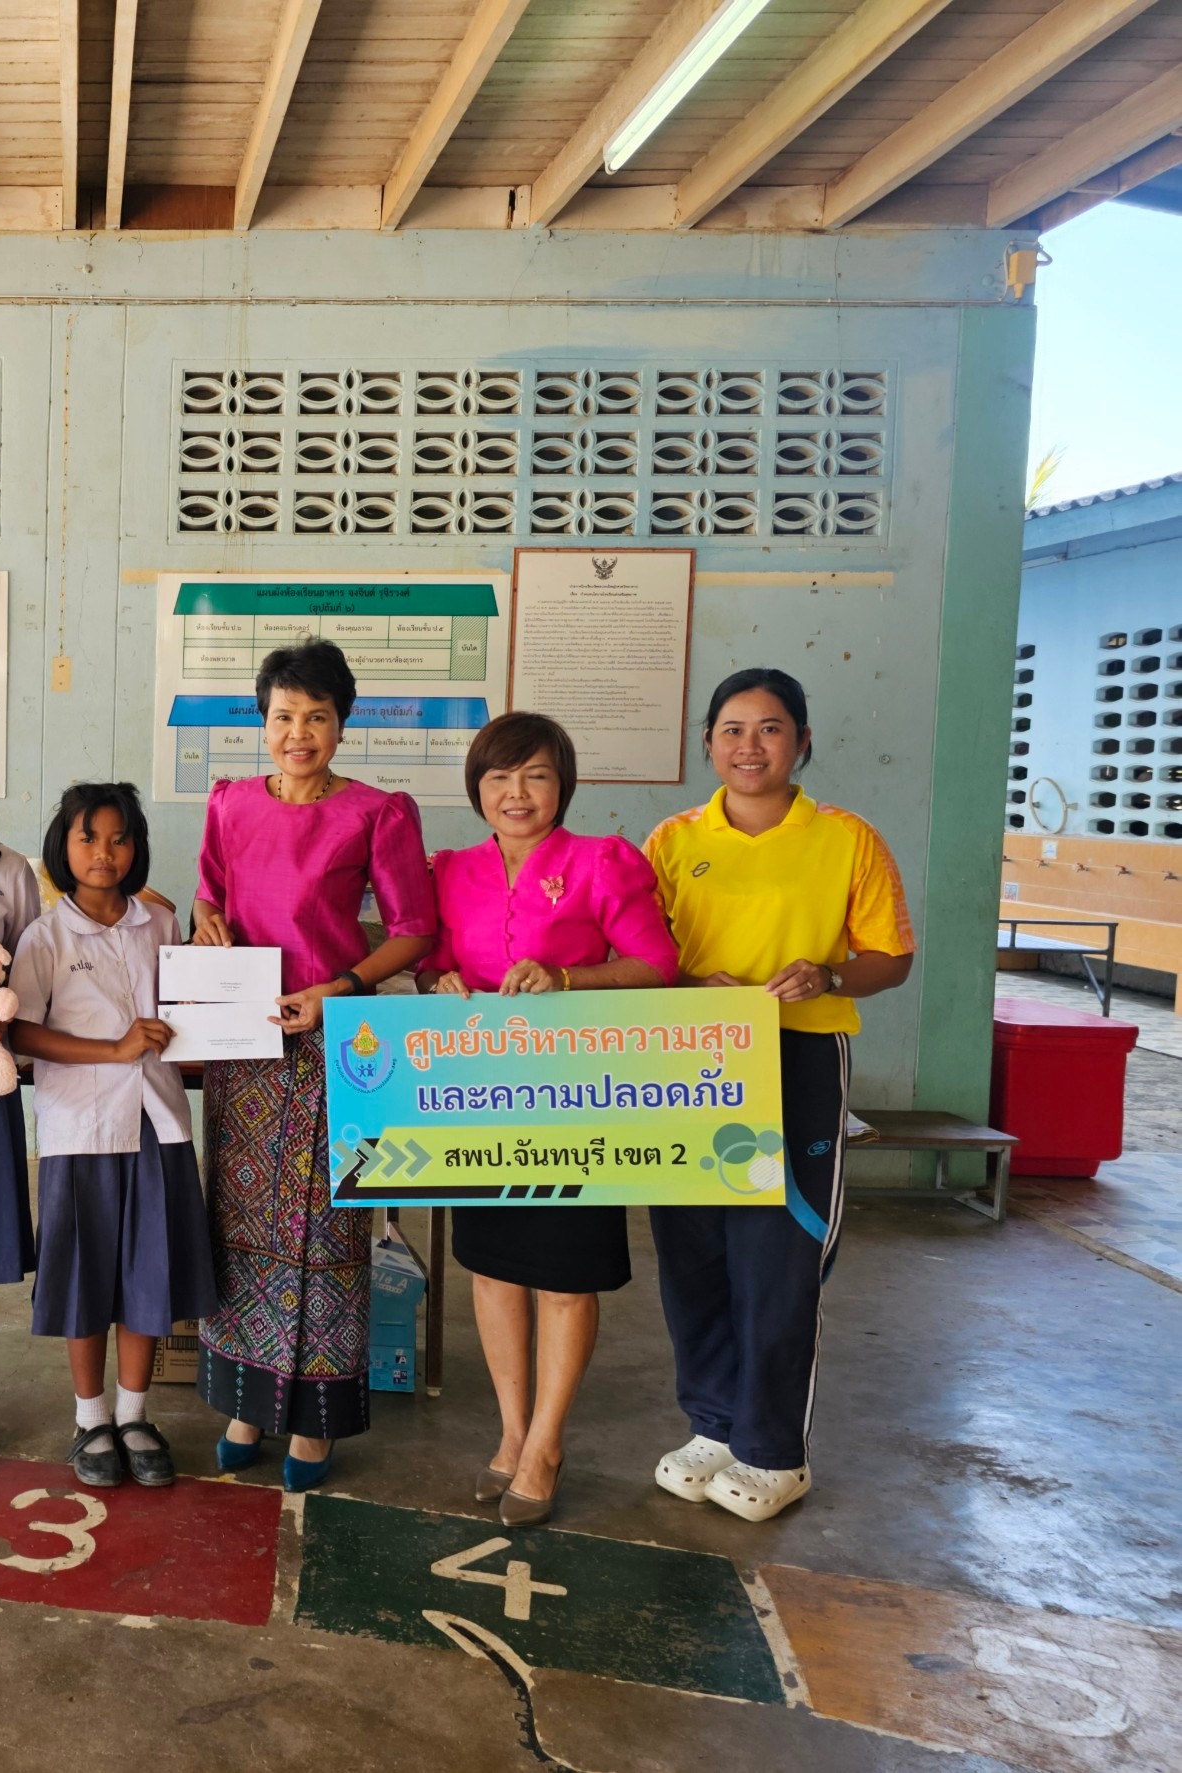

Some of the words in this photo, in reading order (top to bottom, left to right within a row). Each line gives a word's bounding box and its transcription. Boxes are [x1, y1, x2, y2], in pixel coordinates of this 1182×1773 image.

[404, 1013, 753, 1070] ศูนย์บริหารความสุข
[417, 1068, 745, 1112] และความปลอดภัย
[444, 1137, 606, 1176] สพป.จันทบุรี
[614, 1144, 661, 1166] เขต
[670, 1143, 688, 1165] 2
[431, 1536, 568, 1621] 4
